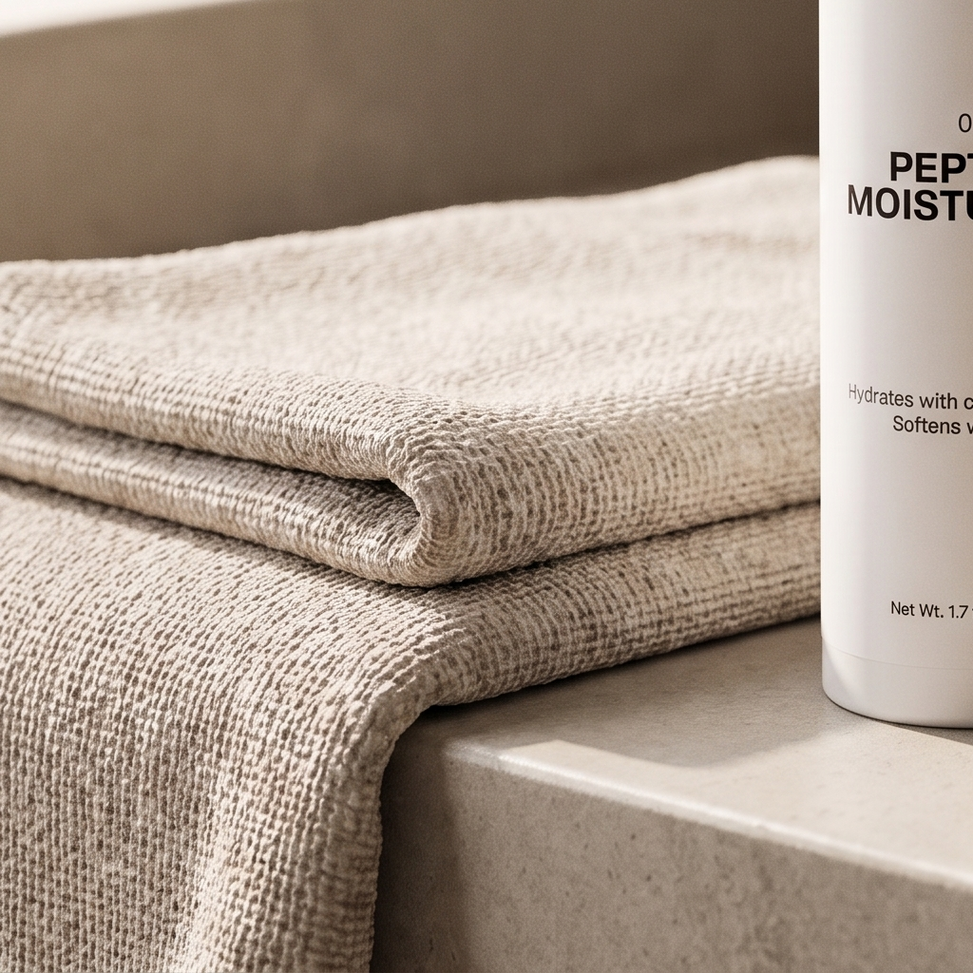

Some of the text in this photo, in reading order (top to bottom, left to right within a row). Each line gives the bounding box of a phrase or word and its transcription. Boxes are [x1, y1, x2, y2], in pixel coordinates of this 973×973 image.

[848, 383, 914, 408] Hydrates
[919, 393, 958, 410] with
[892, 415, 961, 435] Softens
[891, 601, 915, 617] Net
[919, 603, 944, 619] Wt.
[948, 605, 968, 619] 1.7
